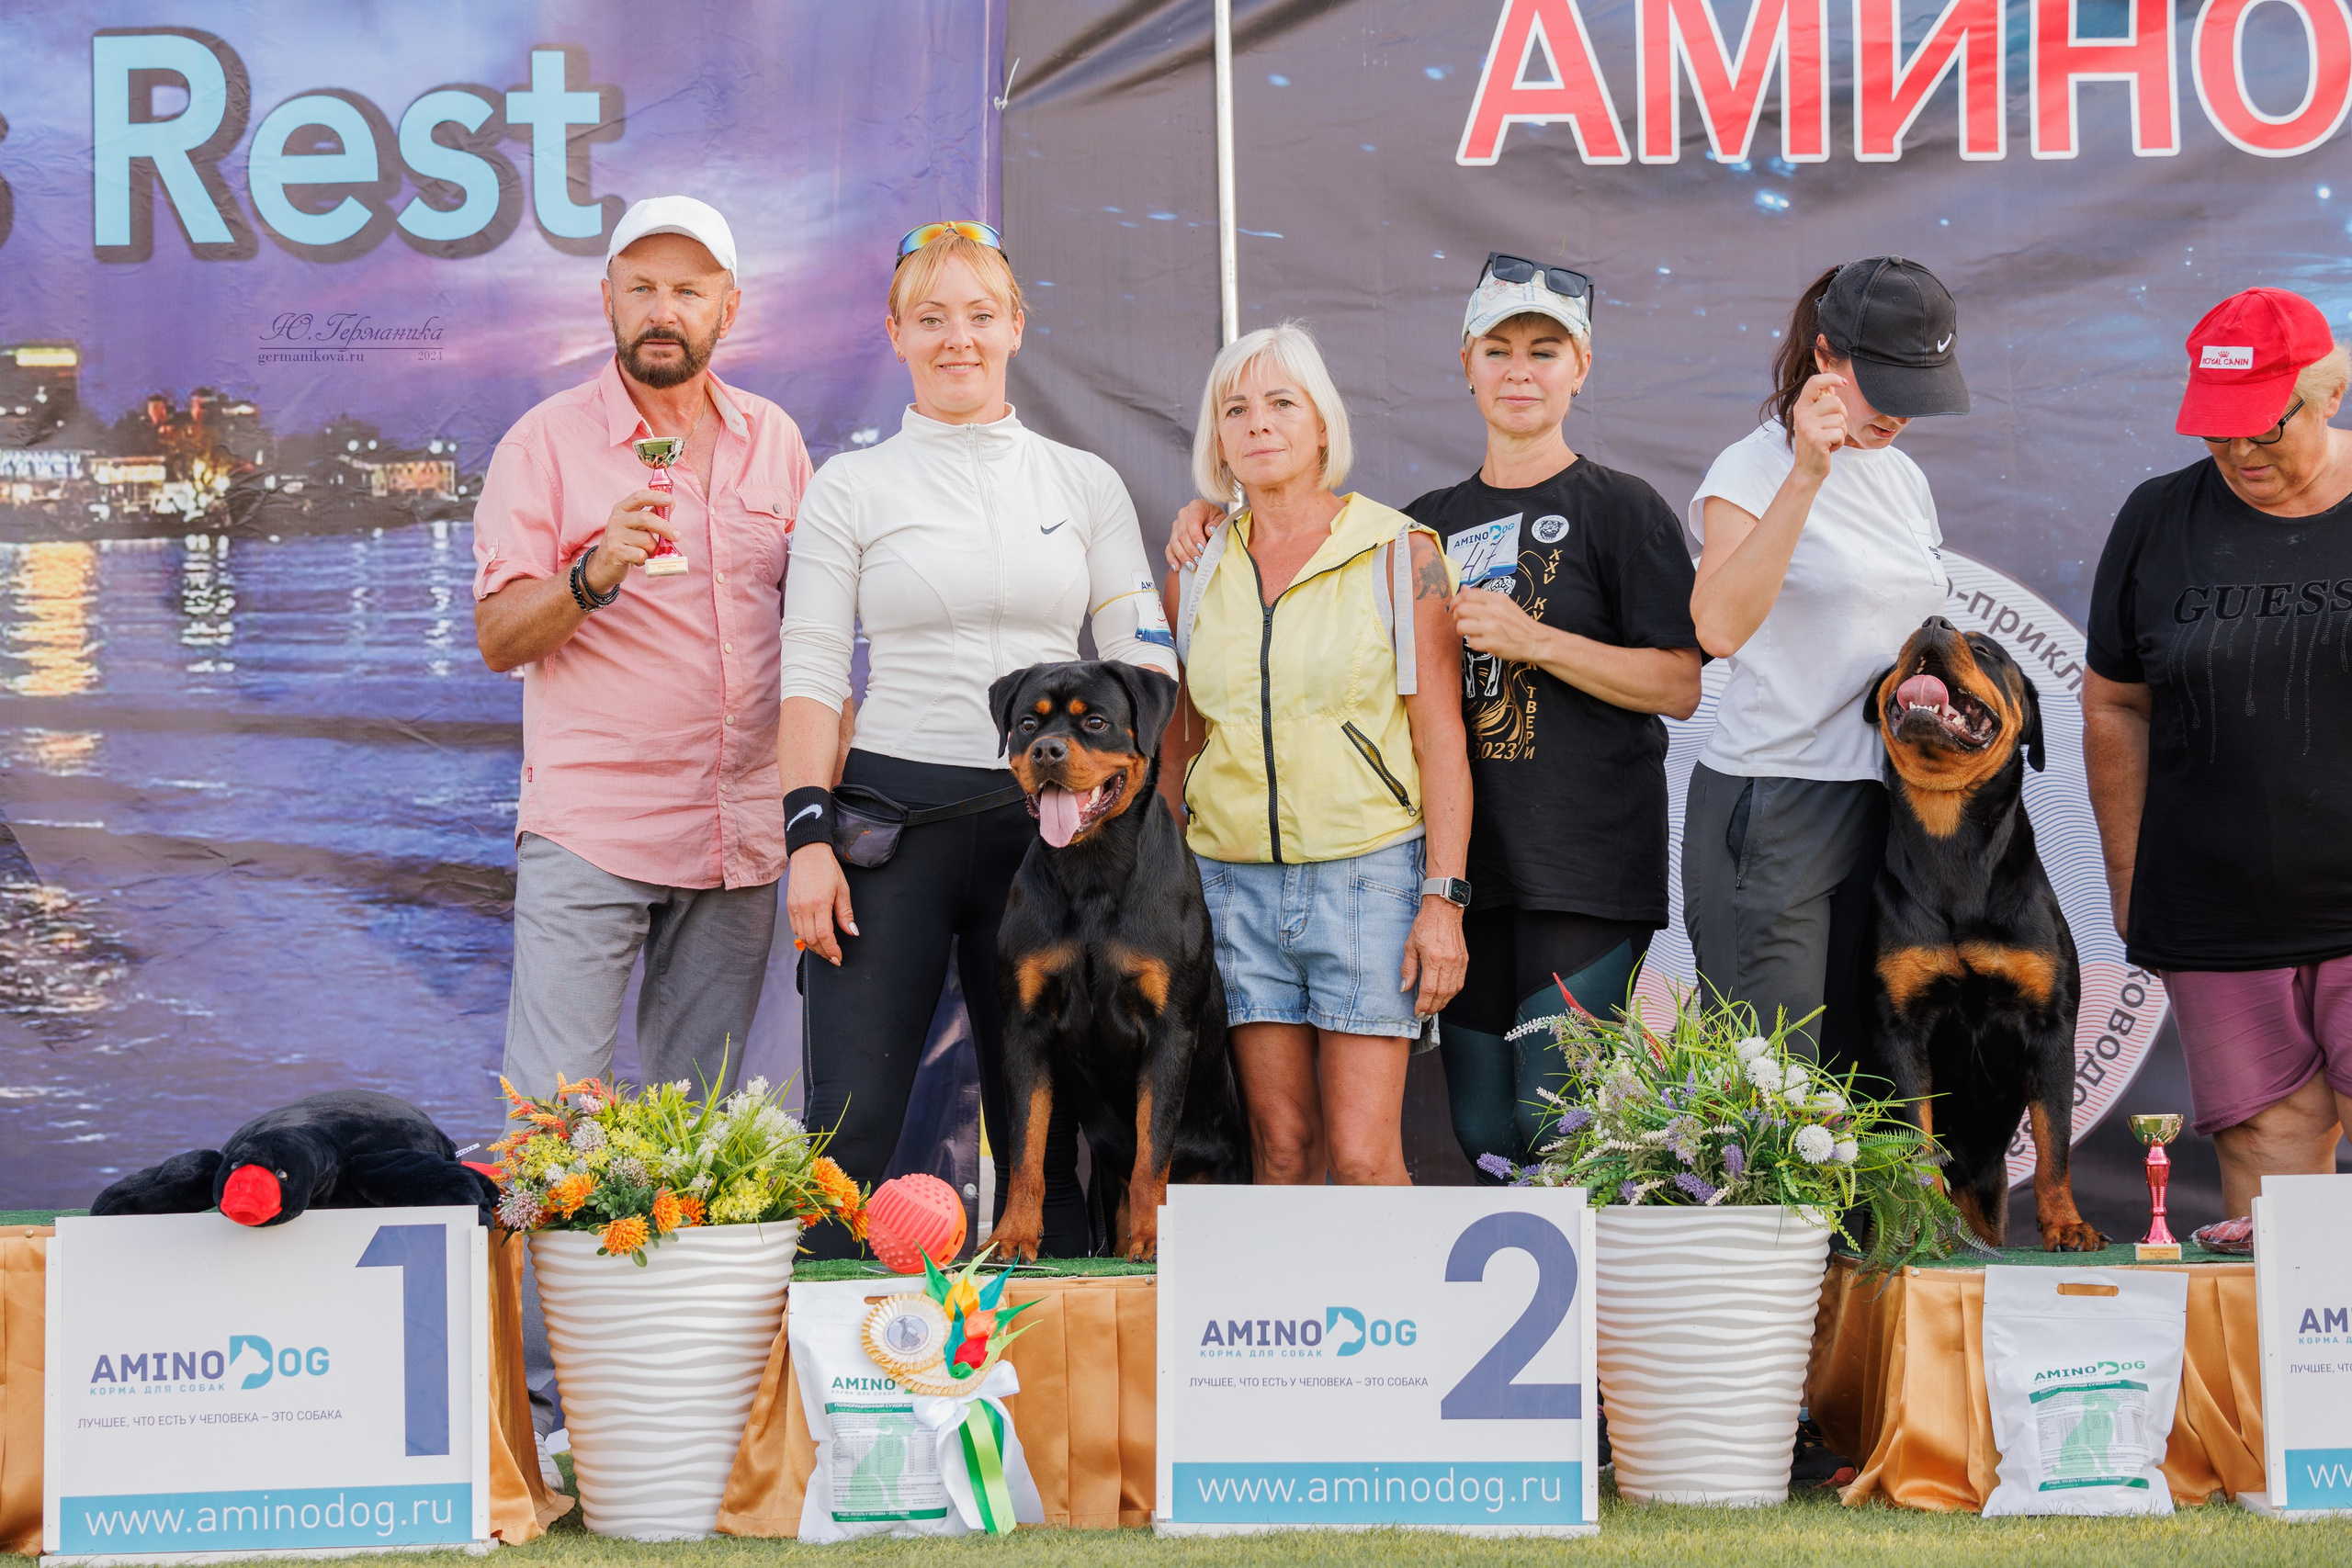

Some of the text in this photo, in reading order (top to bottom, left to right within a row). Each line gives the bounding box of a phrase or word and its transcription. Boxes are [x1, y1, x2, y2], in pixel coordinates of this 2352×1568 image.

[1455, 0, 2352, 165] АМИНО
[93, 35, 603, 246] Rest
[2174, 579, 2352, 624] GUESS
[1947, 577, 2084, 705] -прикл
[1523, 685, 1537, 760] ТВЕРИ
[1201, 1306, 1417, 1357] AMINODOG
[1441, 1212, 1581, 1419] 2
[2299, 1307, 2352, 1334] AM
[90, 1335, 330, 1391] AMINODOG
[356, 1224, 449, 1457] 1
[1200, 1349, 1323, 1359] КОРМА ДЛЯ СОБАК
[2299, 1337, 2338, 1345] КОРМА
[90, 1382, 225, 1396] КОРМА ДЛЯ СОБАК
[831, 1377, 910, 1393] AMINO
[1190, 1378, 1236, 1388] ЛУЧШЕЕ,
[1239, 1378, 1260, 1387] ЧТО
[1262, 1378, 1288, 1387] ЕСТЬ
[1290, 1378, 1296, 1387] У
[1299, 1378, 1352, 1387] ЧЕЛОВЕКА
[1364, 1378, 1385, 1387] ЭТО
[1387, 1377, 1429, 1387] СОБАКА
[2290, 1364, 2335, 1374] ЛУЧШЕЕ,
[78, 1417, 130, 1429] ЛУЧШЕЕ,
[133, 1416, 155, 1427] ЧТО
[159, 1415, 187, 1426] ЕСТЬ
[189, 1415, 197, 1425] У
[199, 1413, 259, 1425] ЧЕЛОВЕКА
[271, 1411, 294, 1422] ЭТО
[297, 1410, 343, 1421] СОБАКА
[1197, 1467, 1560, 1512] www.aminodog.ru
[85, 1493, 452, 1537] www.aminodog.ru
